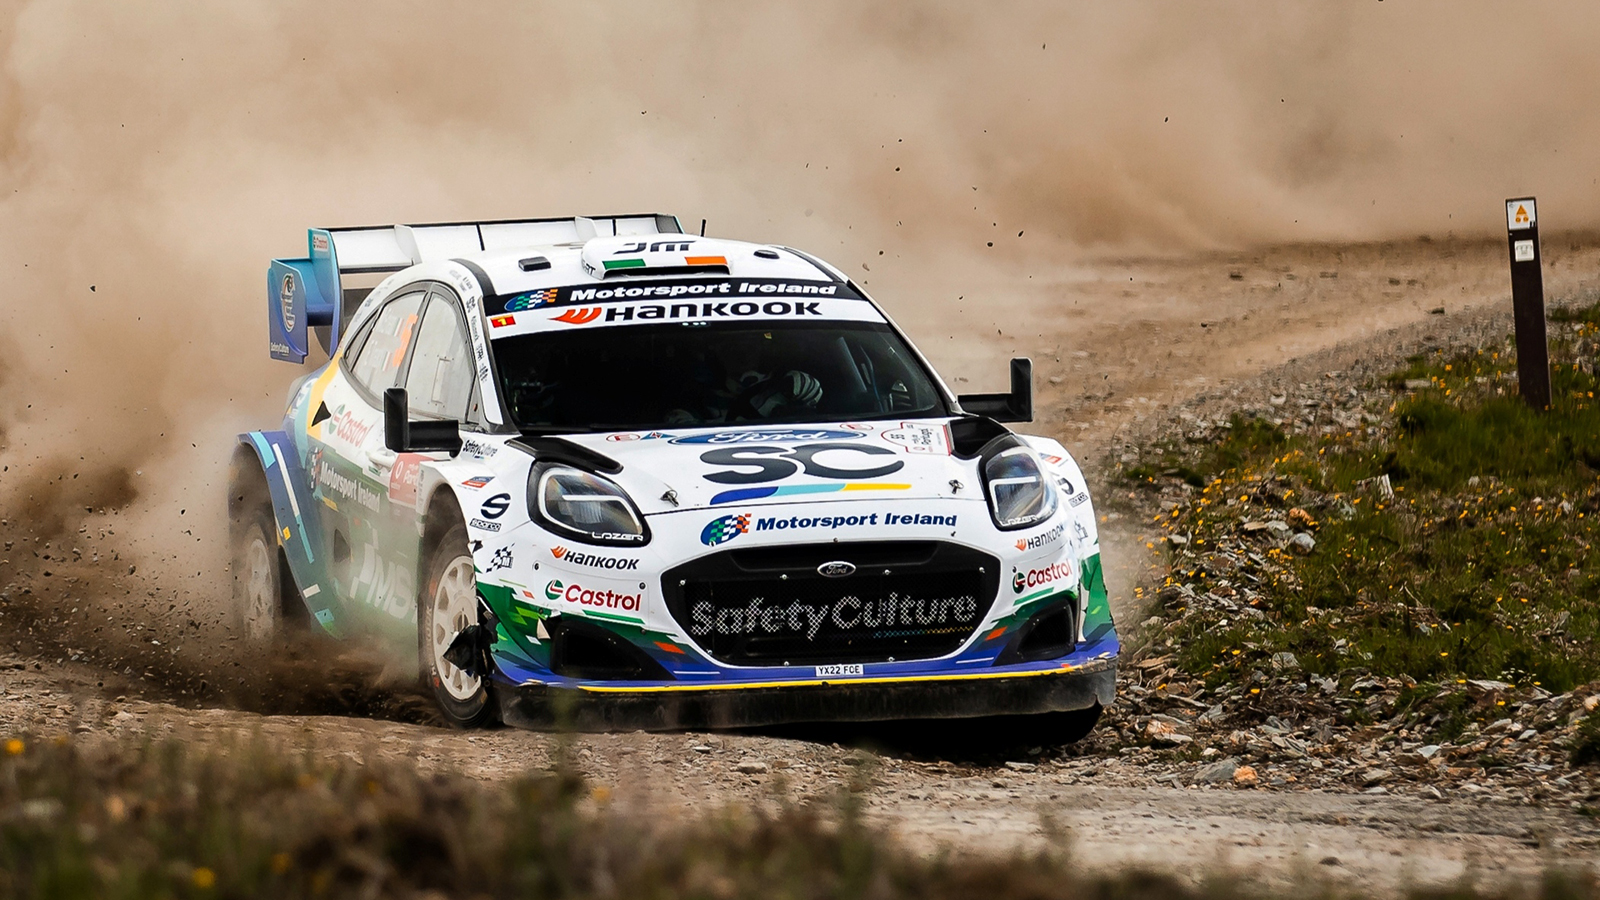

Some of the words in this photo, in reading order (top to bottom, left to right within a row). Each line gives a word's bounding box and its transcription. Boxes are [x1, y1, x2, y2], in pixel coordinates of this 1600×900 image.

[569, 282, 730, 303] Motorsport
[738, 281, 838, 297] Ireland
[336, 410, 375, 449] Castrol
[708, 428, 829, 444] Ford
[700, 443, 905, 484] SC
[320, 461, 358, 500] Motorsport
[358, 478, 381, 513] Ireland
[756, 512, 878, 532] Motorsport
[885, 512, 958, 528] Ireland
[1000, 514, 1038, 526] LAZER
[591, 531, 644, 542] LAZER
[825, 563, 848, 575] Ford
[1026, 559, 1072, 588] Castrol
[565, 584, 642, 612] Castrol
[818, 665, 841, 675] YX22
